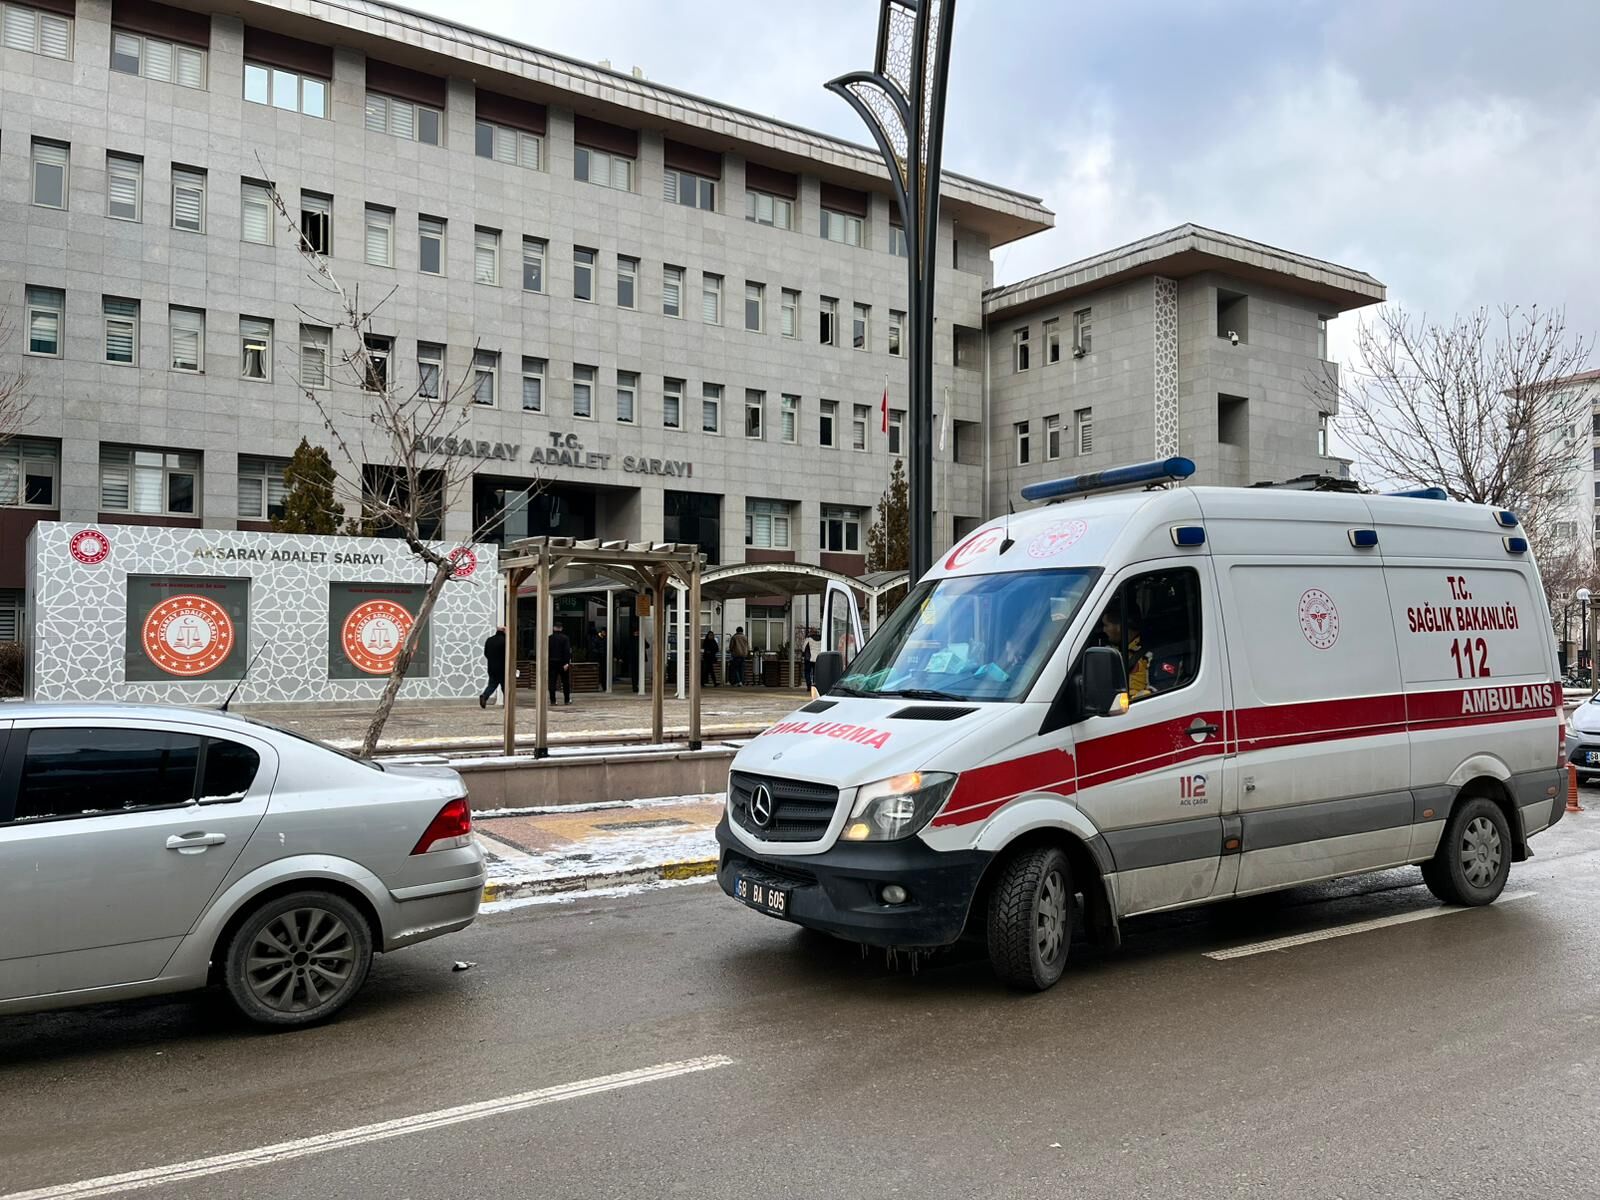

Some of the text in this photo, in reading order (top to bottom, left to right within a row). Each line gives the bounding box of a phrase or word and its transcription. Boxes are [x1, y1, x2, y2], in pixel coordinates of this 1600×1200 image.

[549, 431, 585, 450] T.C.
[414, 434, 693, 478] AKSARAY ADALET SARAYI
[193, 547, 384, 565] AKSARAY ADALET SARAYI
[1447, 576, 1473, 600] T.C.
[1407, 601, 1519, 633] SAĞLIK BAKANLIĞI
[1450, 637, 1491, 679] 112
[1461, 685, 1553, 714] AMBULANS
[1180, 774, 1207, 798] 112
[738, 879, 747, 898] 68
[753, 884, 763, 904] BA
[768, 889, 785, 910] 605
